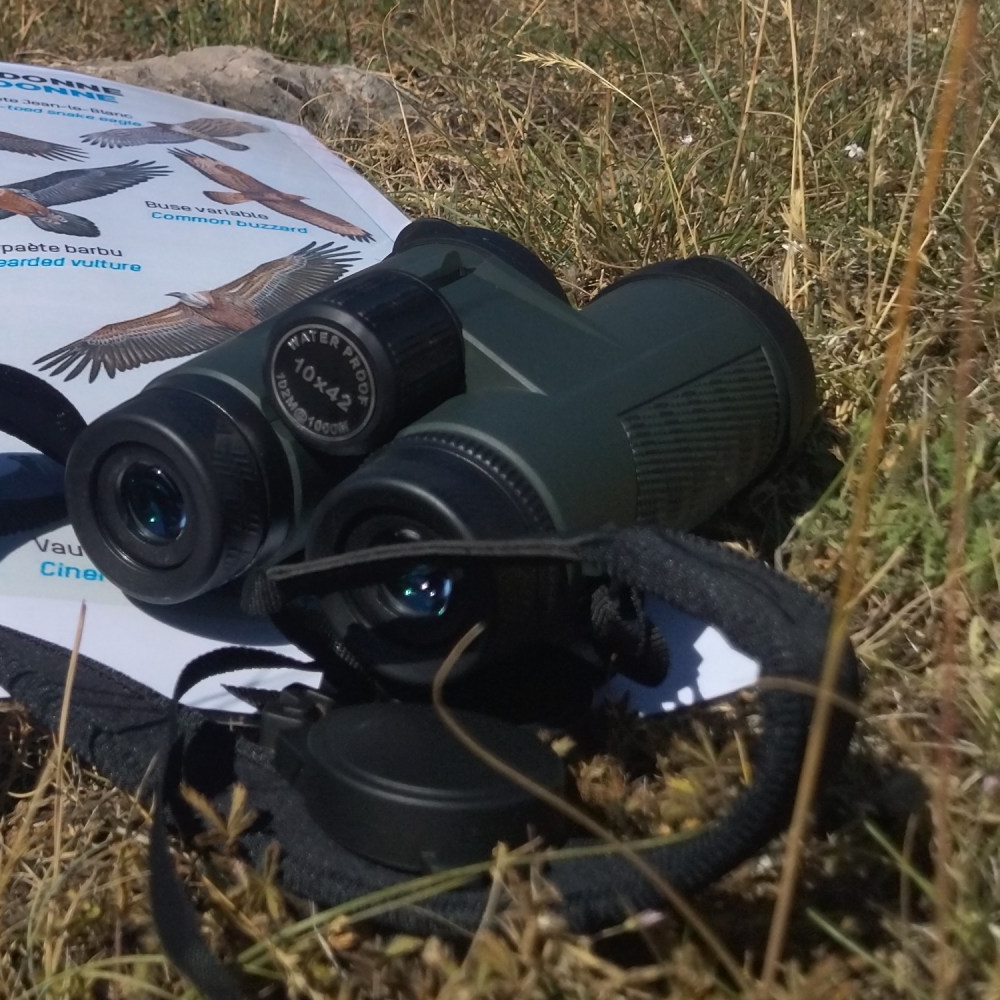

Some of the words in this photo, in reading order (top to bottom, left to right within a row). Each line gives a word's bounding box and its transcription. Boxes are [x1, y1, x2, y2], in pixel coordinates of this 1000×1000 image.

[47, 109, 96, 122] snake
[99, 114, 142, 127] eagle
[145, 200, 191, 212] Buse
[195, 204, 269, 220] variable
[151, 211, 231, 226] Common
[237, 219, 308, 235] buzzard
[65, 244, 123, 258] barbu
[71, 258, 142, 273] vulture
[287, 330, 339, 351] WATER
[342, 346, 369, 407] PROOF
[294, 358, 352, 412] 10x42
[35, 539, 84, 556] Vau
